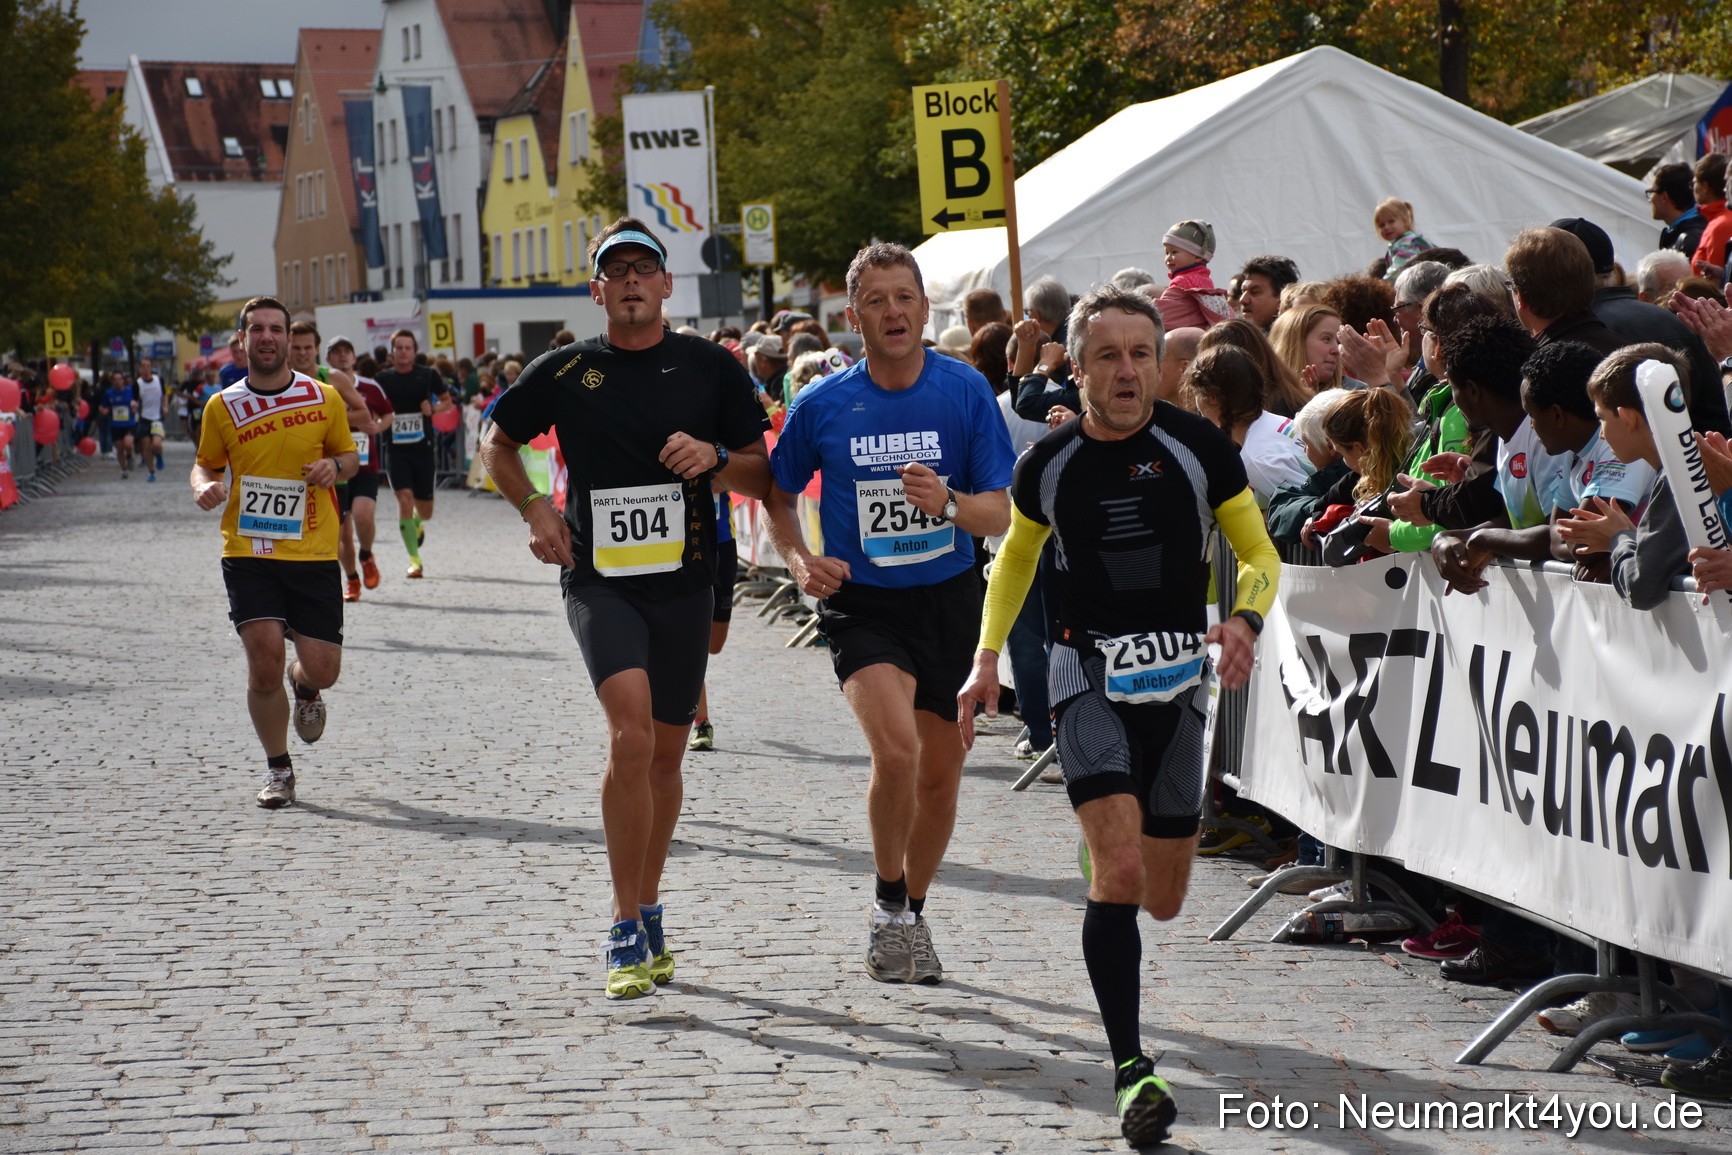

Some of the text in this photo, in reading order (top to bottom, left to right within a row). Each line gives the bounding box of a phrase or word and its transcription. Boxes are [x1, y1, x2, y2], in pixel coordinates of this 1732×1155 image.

[925, 88, 999, 118] Block
[941, 128, 991, 200] B
[52, 330, 66, 348] D
[435, 323, 449, 341] D
[553, 353, 582, 379] HORST
[237, 410, 327, 445] MAX BÖGL
[395, 420, 420, 432] 2476
[850, 430, 941, 456] HUBER
[869, 450, 938, 463] TECHNOLOGY
[1678, 426, 1713, 494] BMW
[870, 465, 891, 473] WASTE
[242, 480, 296, 492] PARTL Neumarkt
[859, 488, 891, 498] PARTL
[245, 491, 300, 517] 2767
[593, 494, 669, 507] PARTL Neumarkt
[252, 519, 288, 531] Andreas
[610, 507, 669, 542] 504
[893, 540, 929, 553] Anton
[1113, 632, 1202, 670] 2504
